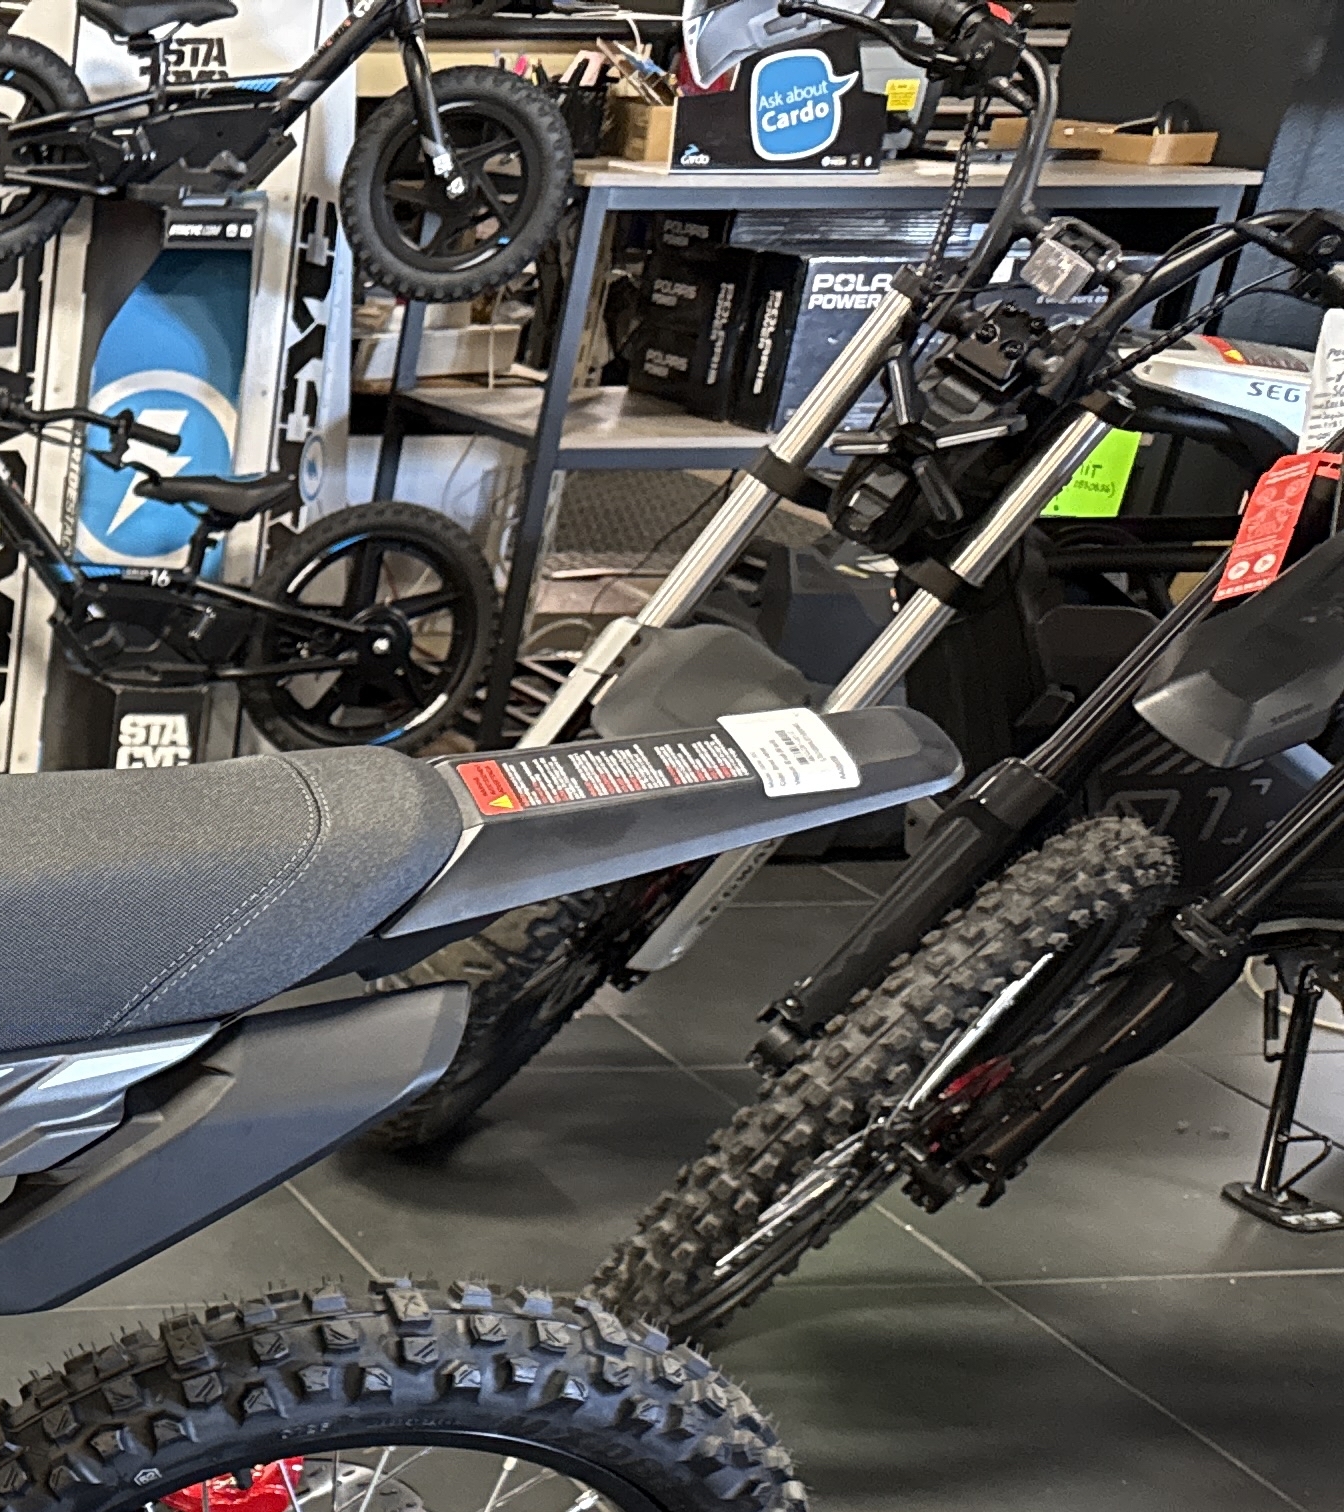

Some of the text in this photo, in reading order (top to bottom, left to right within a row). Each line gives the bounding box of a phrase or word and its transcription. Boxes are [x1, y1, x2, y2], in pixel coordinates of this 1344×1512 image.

[758, 80, 829, 111] Ask about
[761, 100, 830, 133] Cardo
[812, 273, 894, 293] POLA
[808, 293, 883, 310] POWER
[149, 567, 171, 588] 16
[118, 712, 189, 747] STA
